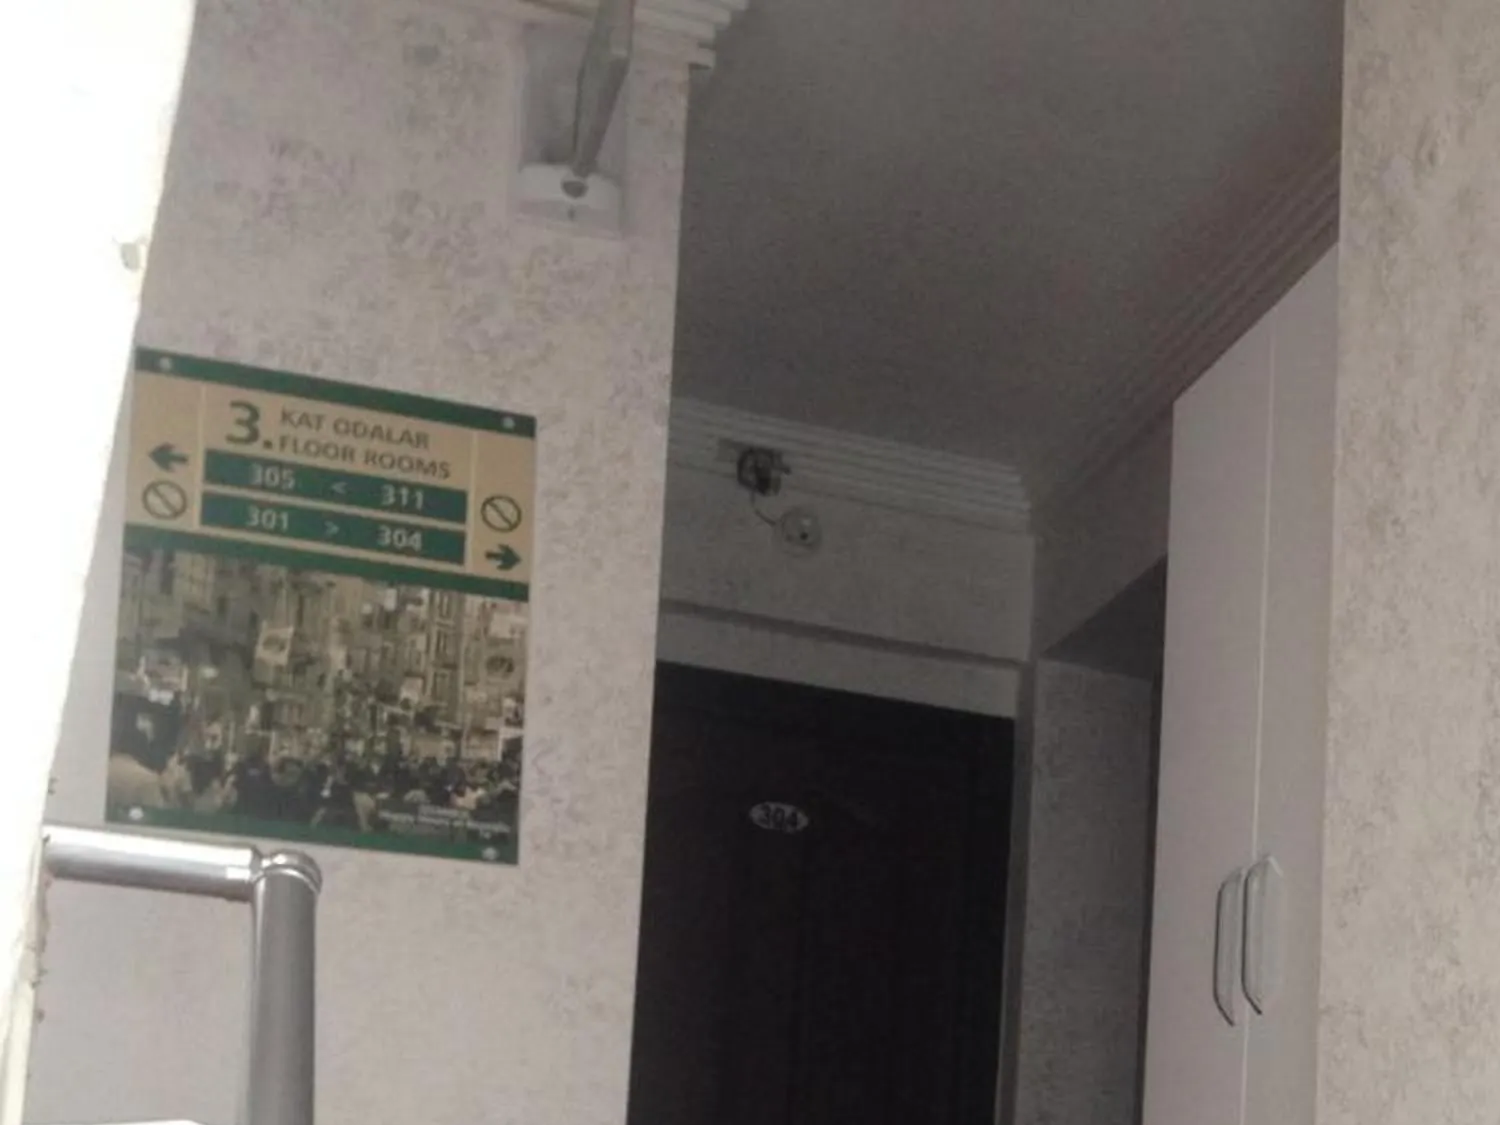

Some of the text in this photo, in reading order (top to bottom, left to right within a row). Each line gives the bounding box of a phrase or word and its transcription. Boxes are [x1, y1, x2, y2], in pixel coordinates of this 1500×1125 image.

[280, 408, 430, 450] KAT ODALAR
[279, 437, 451, 480] FLOOR ROOMS
[250, 462, 425, 511] 305 311
[247, 505, 423, 552] 301 304
